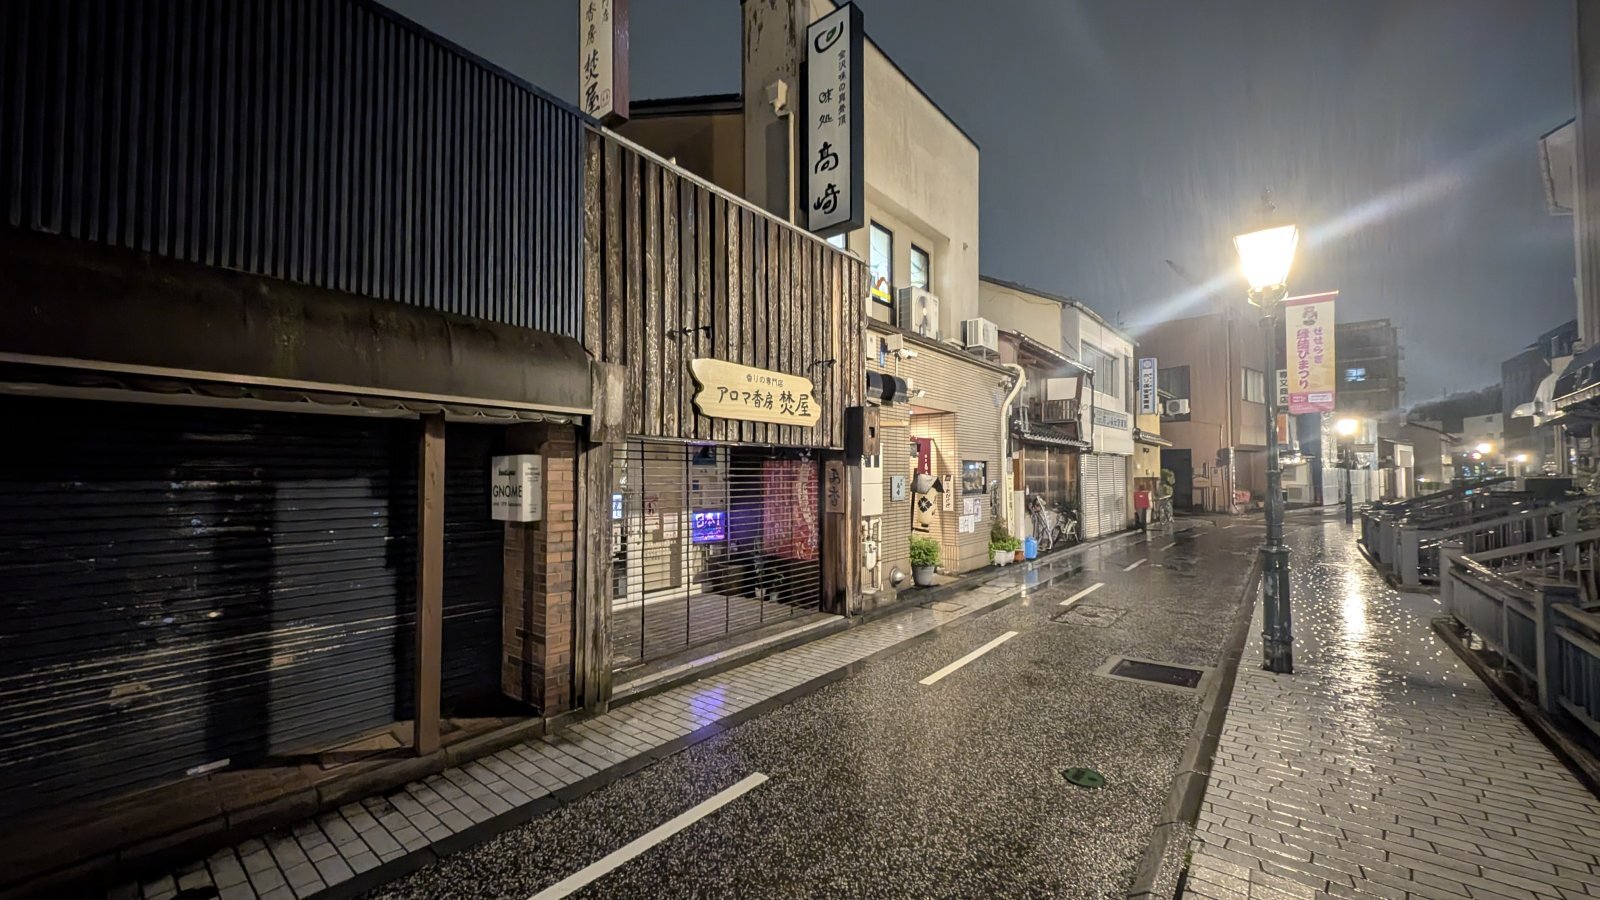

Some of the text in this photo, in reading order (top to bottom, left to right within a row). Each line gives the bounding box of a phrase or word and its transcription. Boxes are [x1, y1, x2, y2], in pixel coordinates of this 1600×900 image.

[716, 386, 812, 418] アロマ香房 焚屋
[493, 485, 522, 497] GNOME
